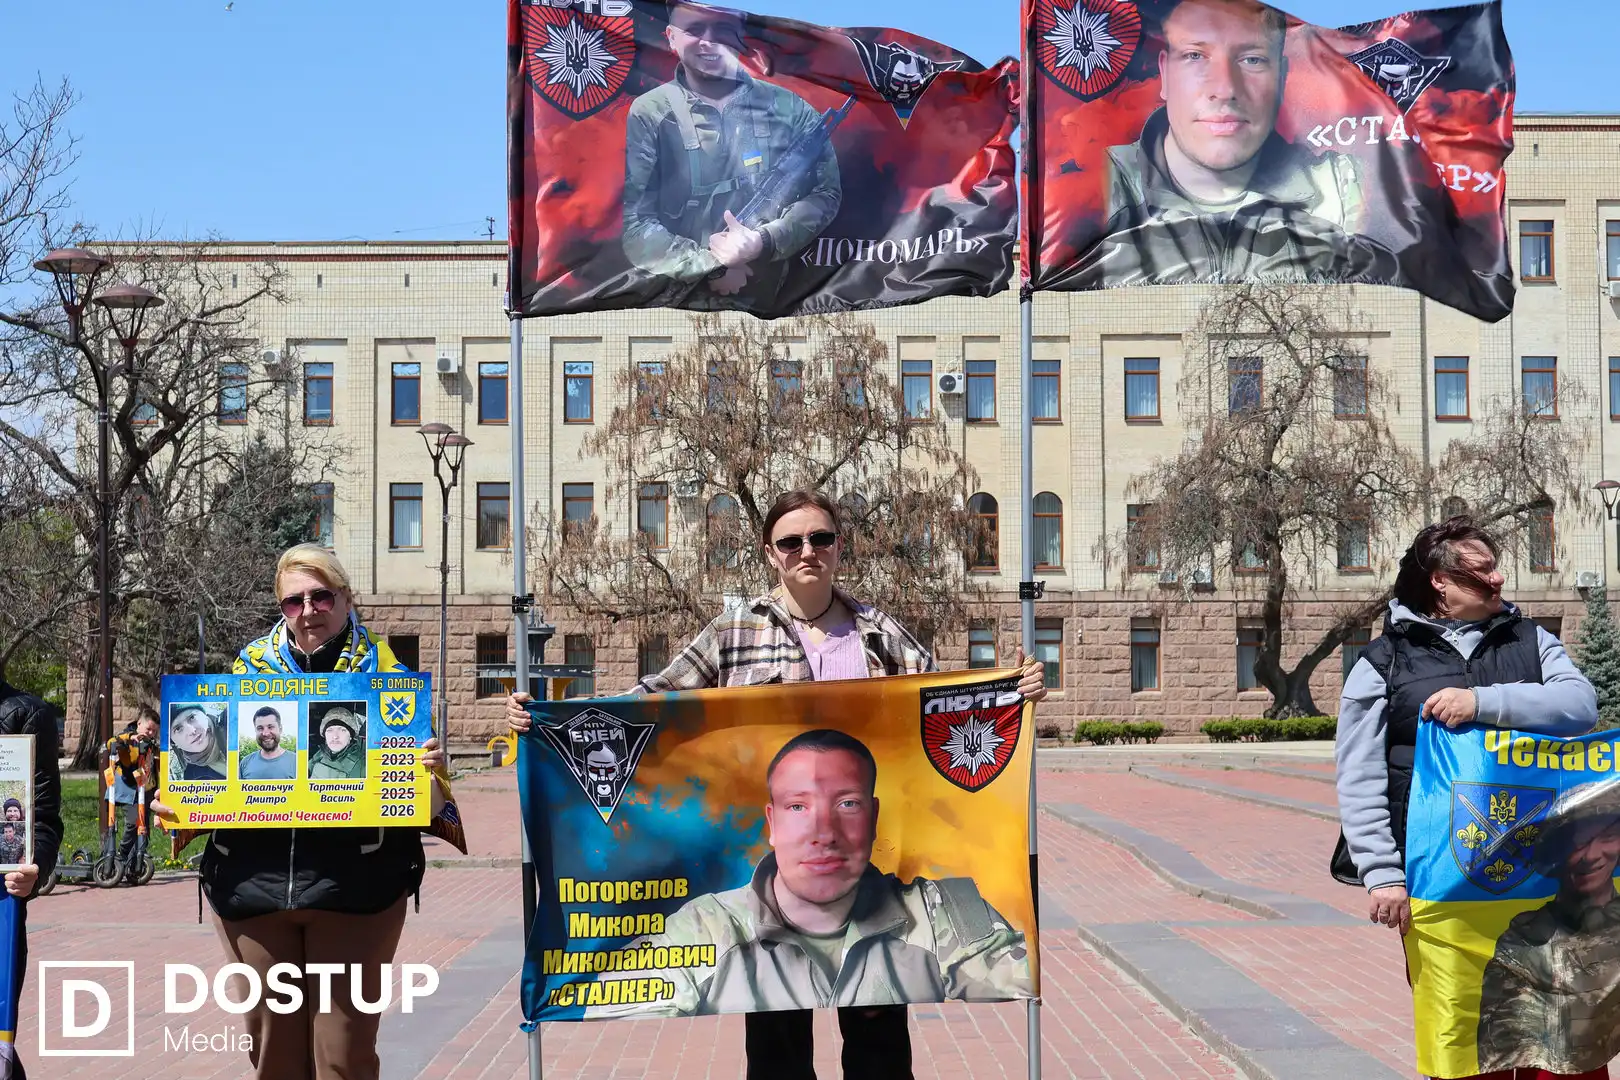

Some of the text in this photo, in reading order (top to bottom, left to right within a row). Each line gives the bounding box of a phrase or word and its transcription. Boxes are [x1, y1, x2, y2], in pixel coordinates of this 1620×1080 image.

[800, 227, 989, 268] «ПОНОМАРЬ»
[197, 678, 328, 699] н.п. ВОДЯНЕ
[371, 678, 424, 691] 56 ОМПБр
[995, 680, 1018, 689] БРИГАД
[925, 690, 1021, 714] ЛЮТЬ
[381, 737, 415, 748] 2022
[381, 754, 415, 765] 2023
[381, 770, 415, 782] 2024
[168, 783, 227, 794] Онофрійчук
[309, 782, 364, 793] Тартачний
[320, 794, 355, 803] Василь
[381, 788, 415, 799] 2025
[181, 795, 213, 806] Андрій
[246, 795, 287, 806] Дмитро
[381, 805, 415, 816] 2026
[189, 810, 352, 824] Віримо! Любимо! Чекаємо!
[558, 877, 688, 905] Погорєлов
[568, 912, 665, 938] Микола
[543, 943, 717, 975] Миколайович
[548, 977, 674, 1007] «СТАЛКЕР»
